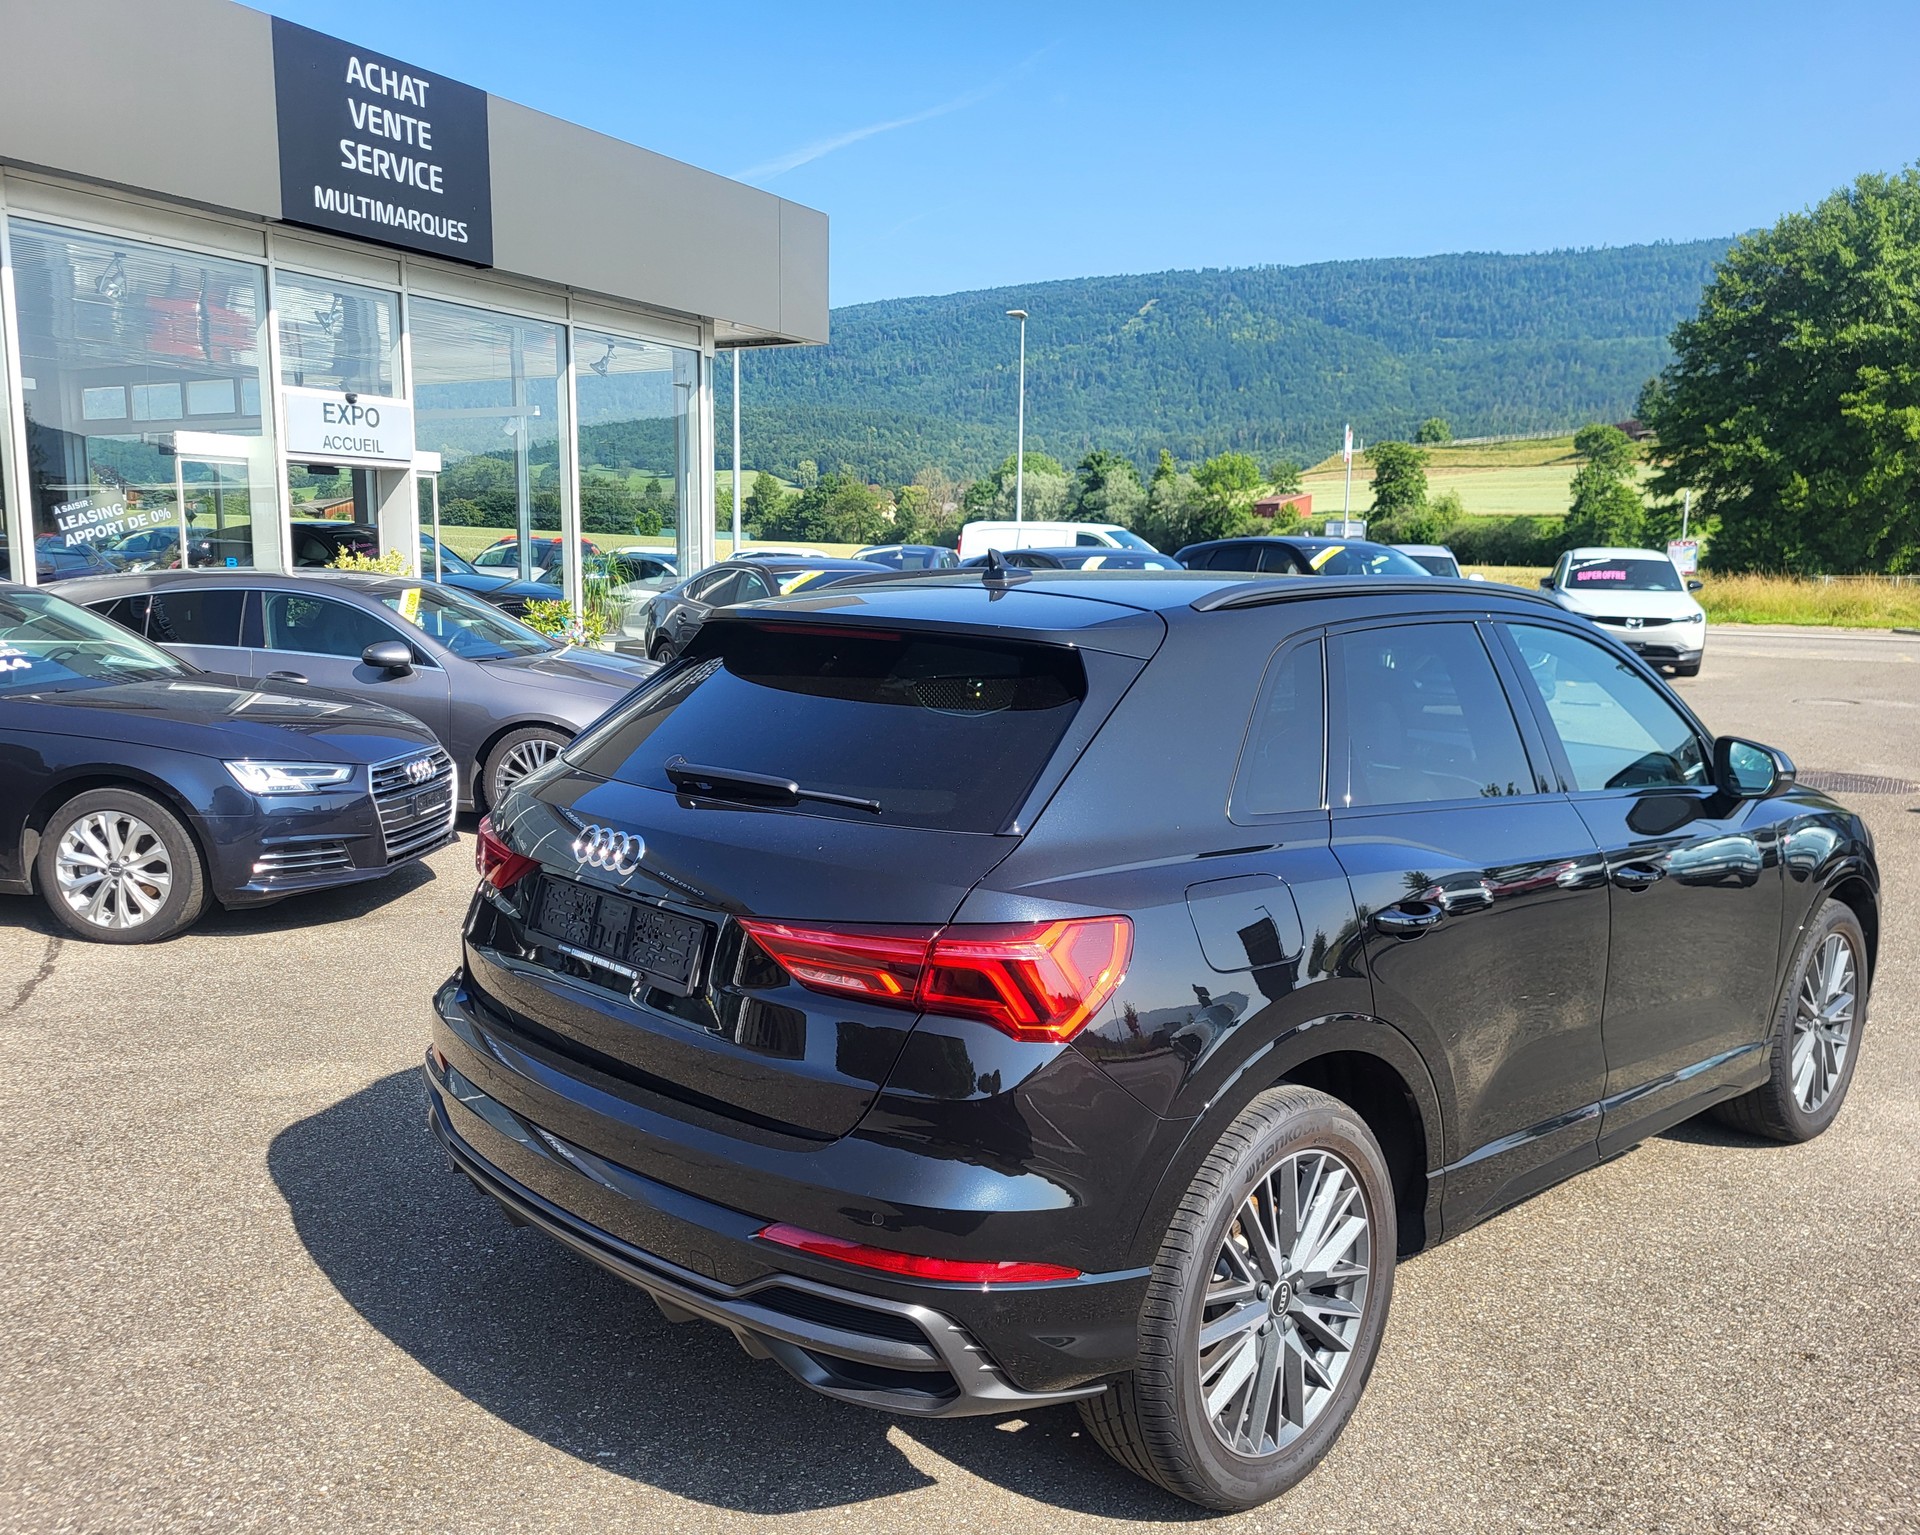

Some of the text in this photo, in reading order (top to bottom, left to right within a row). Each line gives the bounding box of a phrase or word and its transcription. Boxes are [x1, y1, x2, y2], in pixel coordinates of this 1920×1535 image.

[346, 56, 430, 108] ACHAT
[347, 97, 433, 151] VENTE
[339, 139, 444, 194] SERVICE
[314, 185, 468, 243] MULTIMARQUES
[322, 402, 381, 428] EXPO
[322, 435, 384, 454] ACCUEIL
[58, 503, 123, 530] LEASING
[62, 501, 88, 512] SAISIR
[65, 507, 171, 547] APPORT DE 0%
[1577, 570, 1626, 581] SUPER OFFRE
